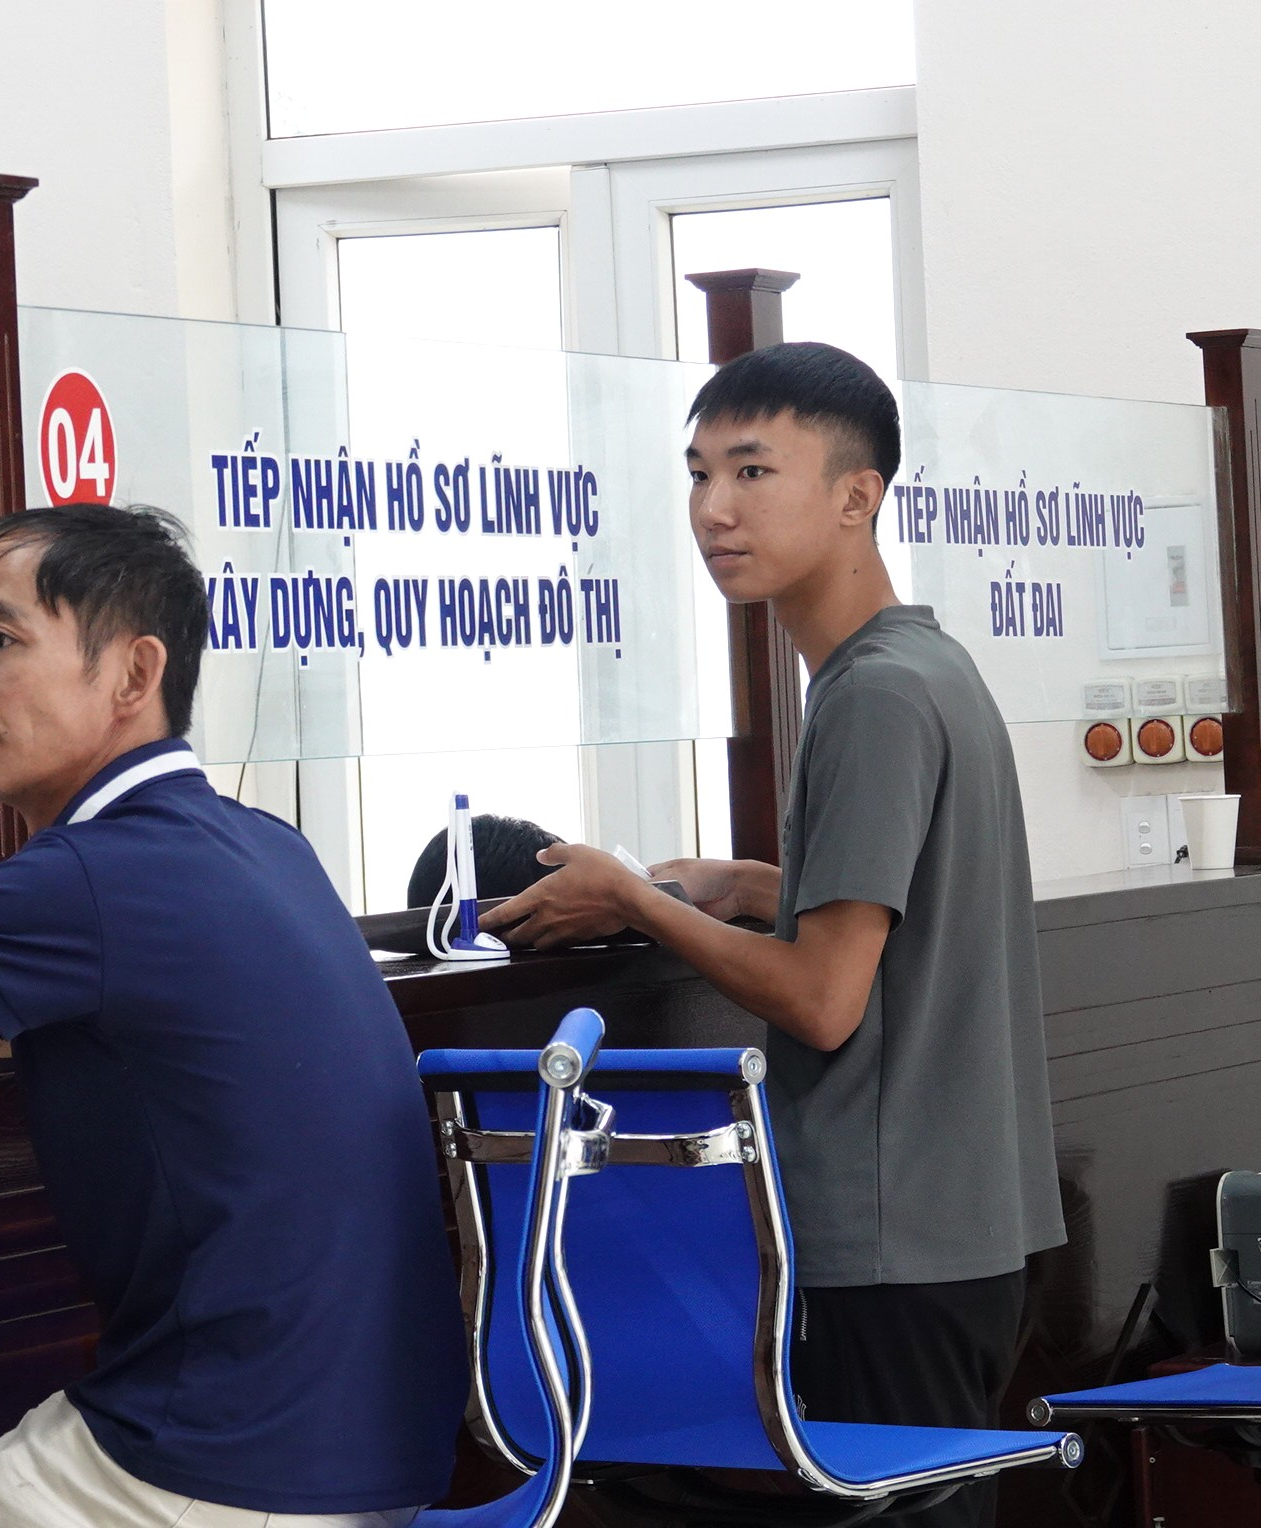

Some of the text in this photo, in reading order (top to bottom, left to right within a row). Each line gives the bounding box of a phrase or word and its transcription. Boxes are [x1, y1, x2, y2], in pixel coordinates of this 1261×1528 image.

[47, 406, 111, 500] 04
[210, 429, 600, 552] TIẾP NHẬN HỒ SƠ LĨNH VỰC
[893, 465, 1146, 560] TIẾP NHẬN HỒ SƠ LĨNH VỰC
[268, 569, 365, 668] DỰNG,
[372, 578, 429, 657] QUY
[437, 578, 531, 662] HOẠCH
[537, 565, 574, 645] ĐÔ
[579, 578, 621, 661] THỊ
[990, 561, 1064, 638] ĐẤT ĐAI
